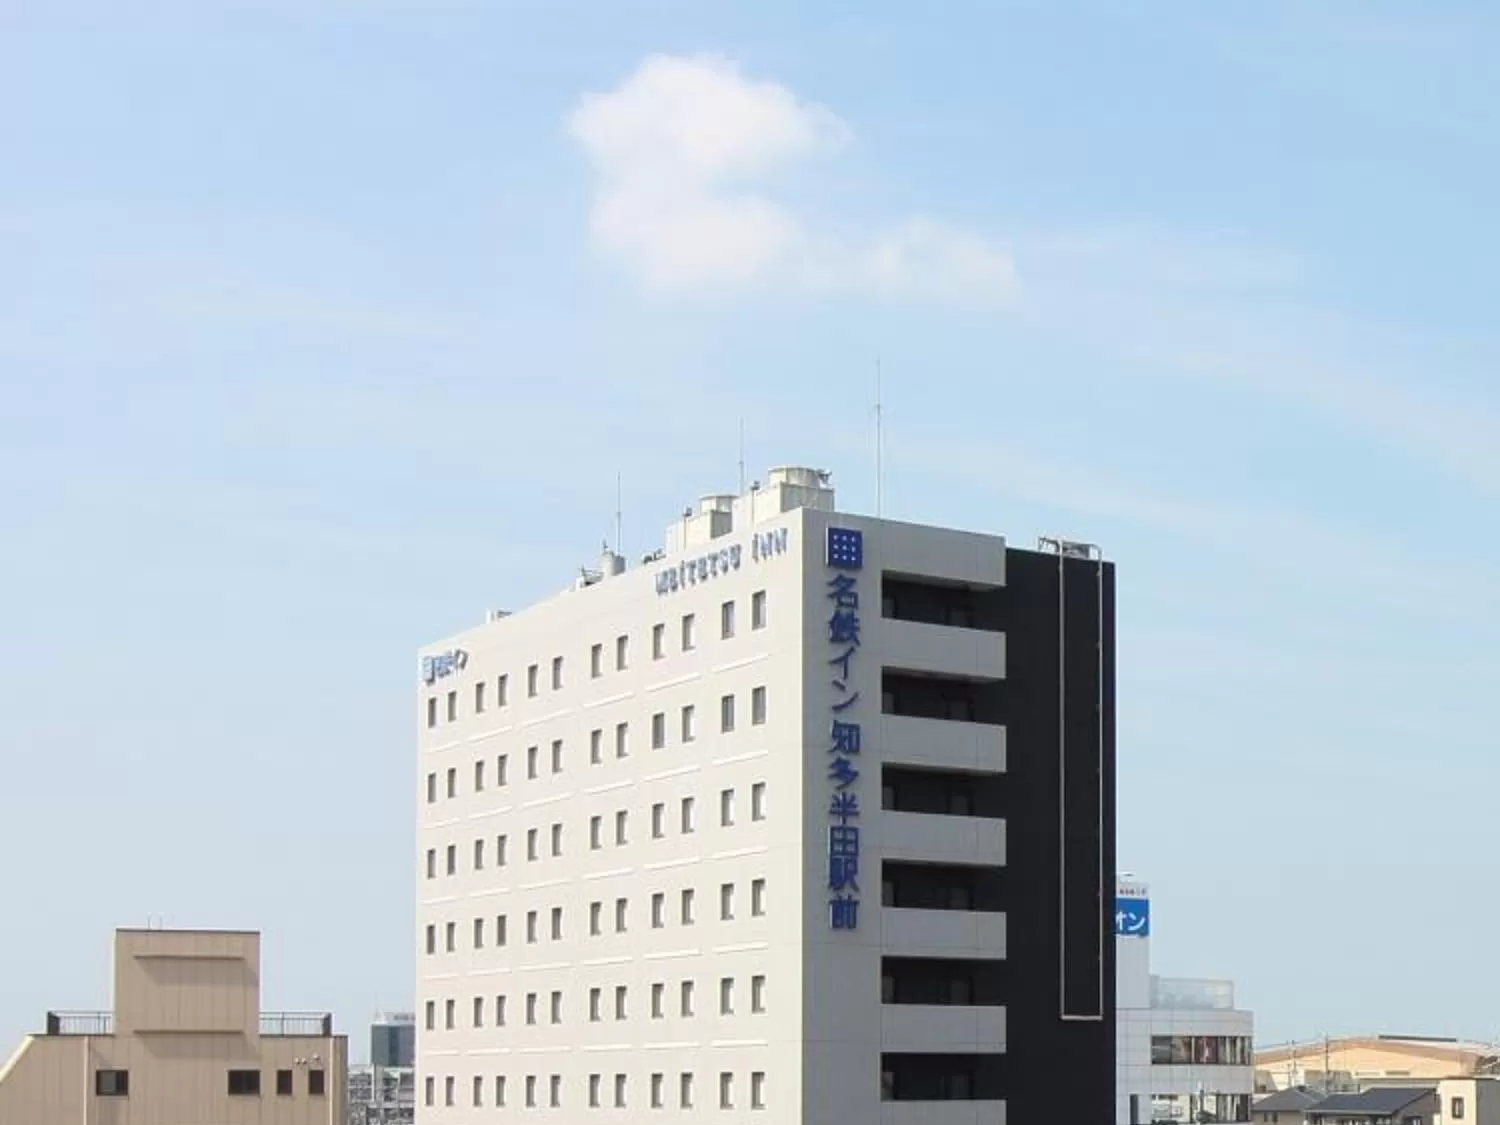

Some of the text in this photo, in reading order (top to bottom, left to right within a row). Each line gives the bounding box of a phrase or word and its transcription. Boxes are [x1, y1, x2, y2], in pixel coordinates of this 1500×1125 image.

[827, 574, 861, 930] 名鉄イン知多半田駅前
